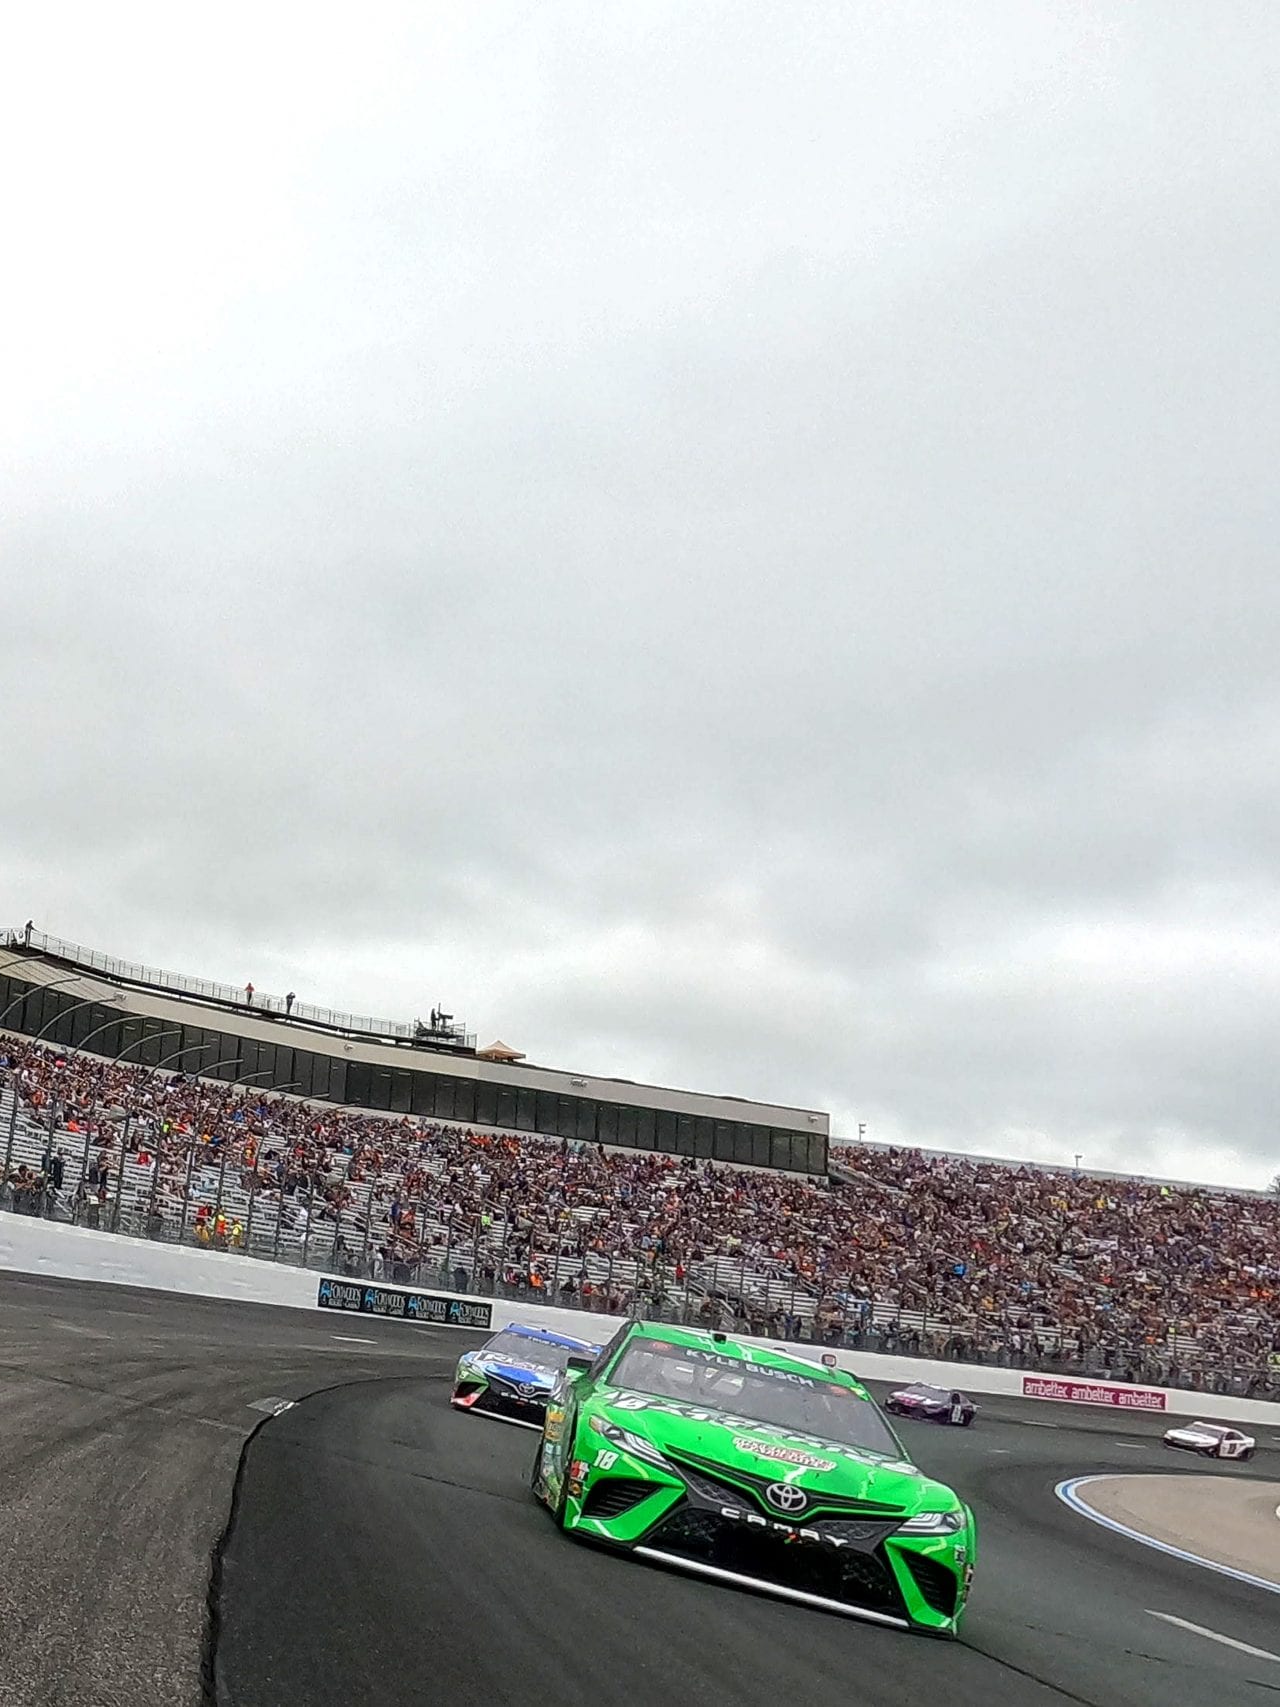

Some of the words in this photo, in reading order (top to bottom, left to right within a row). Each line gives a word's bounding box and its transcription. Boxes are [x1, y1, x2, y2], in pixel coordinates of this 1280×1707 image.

[686, 1349, 740, 1368] KYLE
[745, 1362, 815, 1388] BUSCH
[1025, 1381, 1068, 1399] ambetter
[1071, 1386, 1115, 1403] ambetter
[1118, 1392, 1162, 1408] ambetter
[593, 1448, 620, 1471] 18
[721, 1507, 848, 1547] CAMRY
